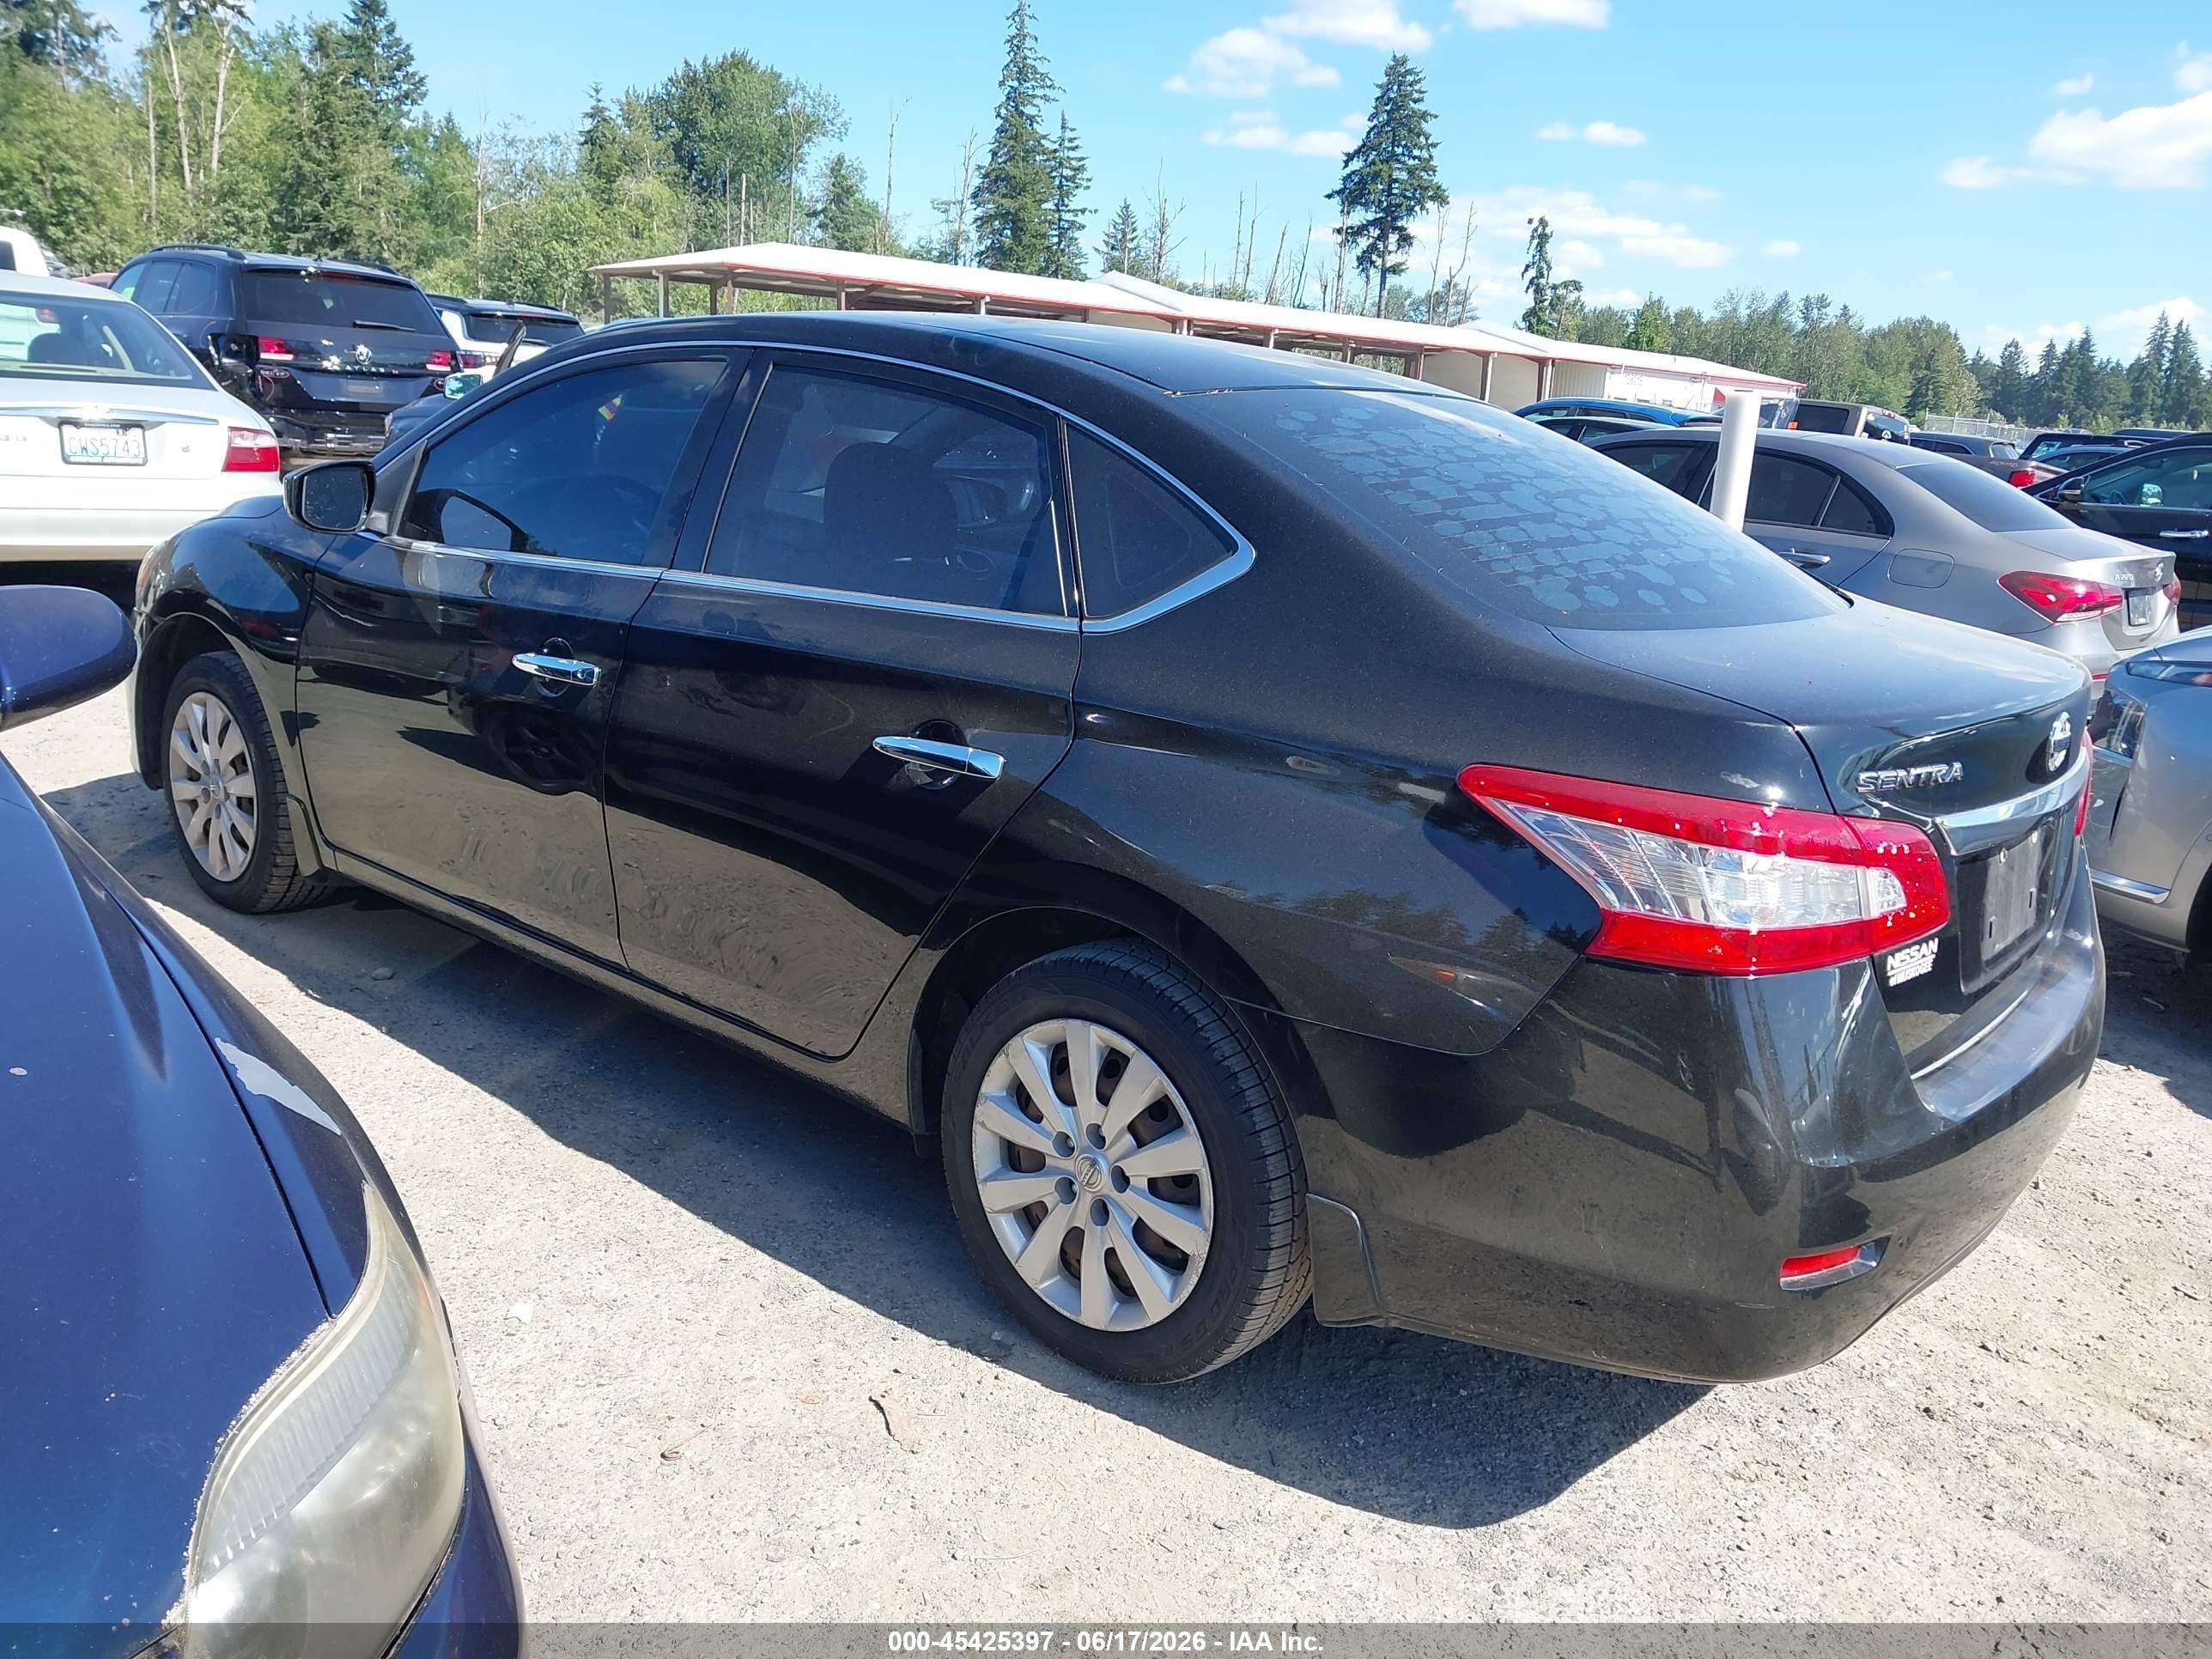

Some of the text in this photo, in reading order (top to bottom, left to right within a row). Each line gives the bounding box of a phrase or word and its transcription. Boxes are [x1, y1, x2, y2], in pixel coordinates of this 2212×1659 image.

[345, 363, 386, 373] ATLAS
[69, 436, 141, 458] CWS5743
[2114, 573, 2134, 581] A220
[1856, 761, 1965, 793] SENTRA
[1887, 937, 1939, 971] NISSAN
